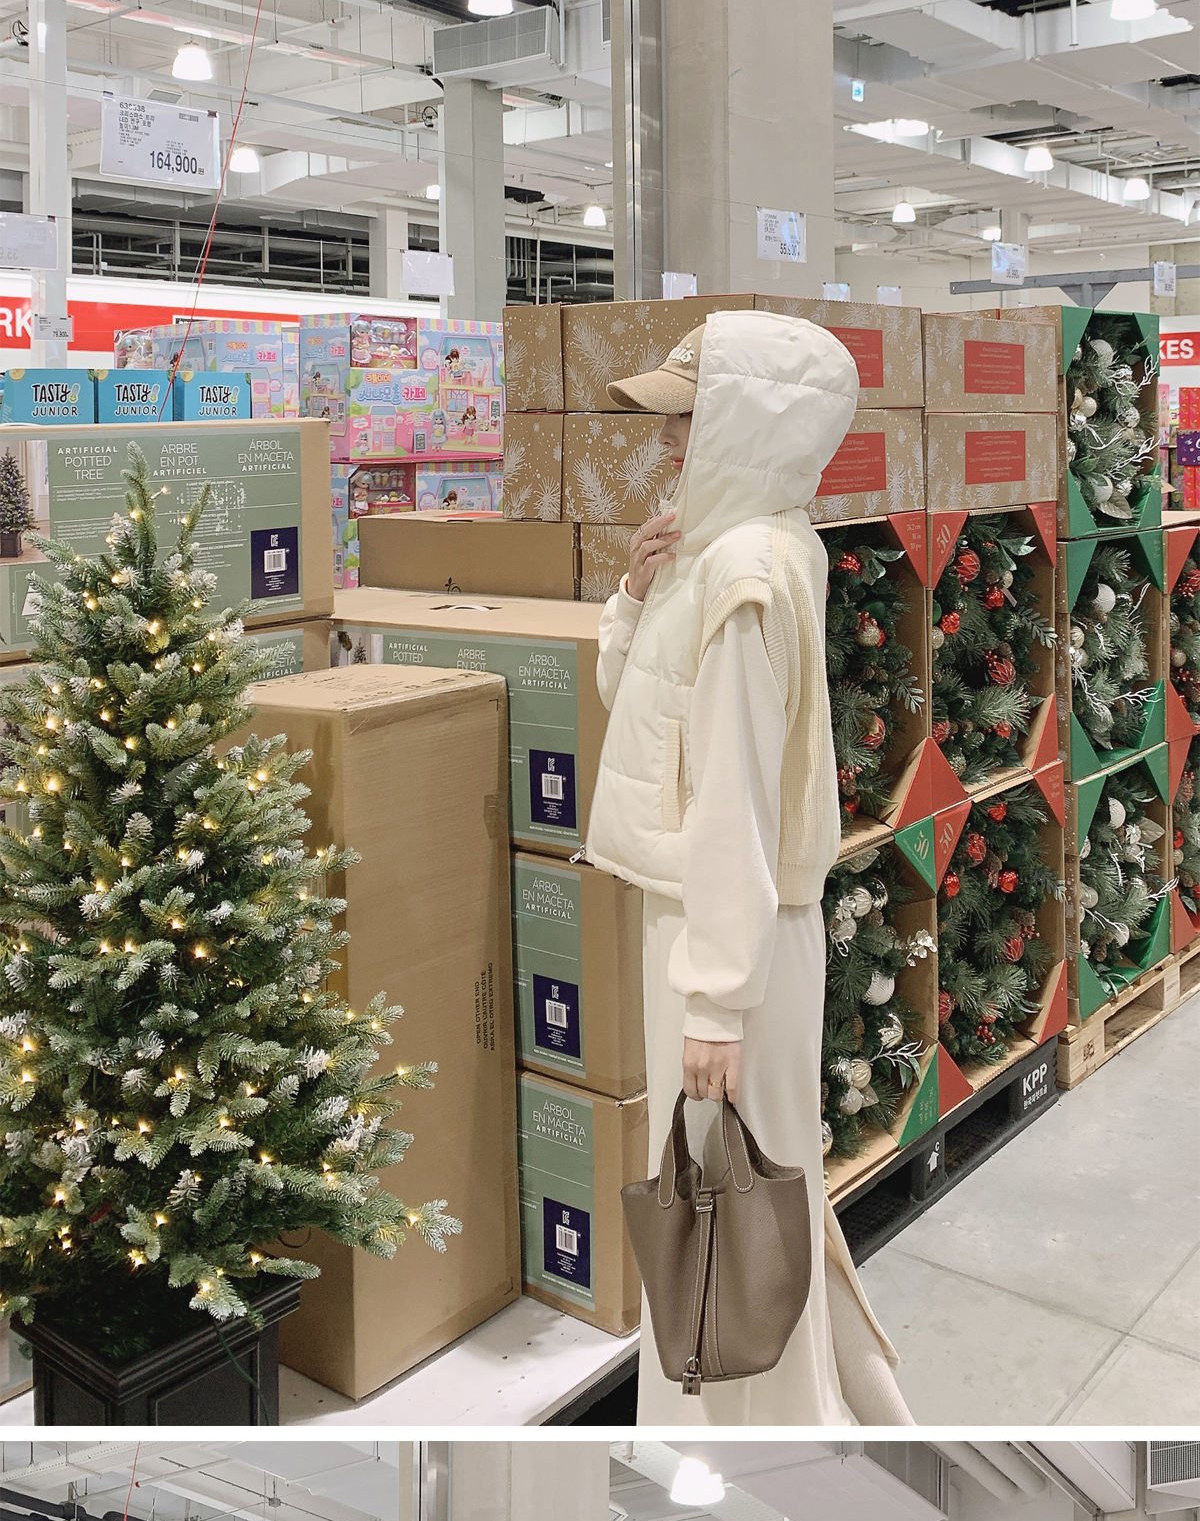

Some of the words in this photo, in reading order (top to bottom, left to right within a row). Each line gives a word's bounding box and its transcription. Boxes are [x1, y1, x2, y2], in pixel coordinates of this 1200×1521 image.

[402, 385, 428, 401] 카페
[32, 405, 78, 417] JUNIOR
[115, 405, 158, 417] JUNIOR
[199, 405, 238, 417] JUNIOR
[58, 445, 118, 455] ARTIFICIAL
[161, 442, 198, 454] ARBRE
[249, 439, 283, 451] ÁRBOL
[65, 456, 112, 468] POTTED
[160, 456, 175, 468] EN
[178, 455, 198, 467] POT
[238, 453, 252, 464] EN
[254, 451, 294, 463] MACETA
[152, 467, 207, 477] ARTIFICIEL
[241, 463, 291, 472] ARTIFICIAL
[74, 468, 104, 480] TREE
[936, 524, 951, 554] 50
[389, 642, 428, 652] ARTIFICIAL
[392, 651, 424, 663] POTTED
[457, 648, 486, 661] ARBRE
[528, 652, 560, 667] ÁRBOL
[456, 660, 469, 670] EN
[472, 661, 487, 672] POT
[518, 665, 531, 677] EN
[533, 666, 571, 681] MACETA
[521, 679, 568, 690] ARTIFICIAL
[532, 877, 564, 896] ÁRBOL
[522, 889, 535, 902] EN
[536, 892, 575, 911] MACETA
[525, 902, 572, 919] ARTIFICIAL
[1022, 1062, 1048, 1096] KPP
[542, 1099, 575, 1121] ÁRBOL
[532, 1111, 546, 1125] EN
[547, 1114, 586, 1138] MACETA
[536, 1125, 584, 1146] ARTIFICIAL
